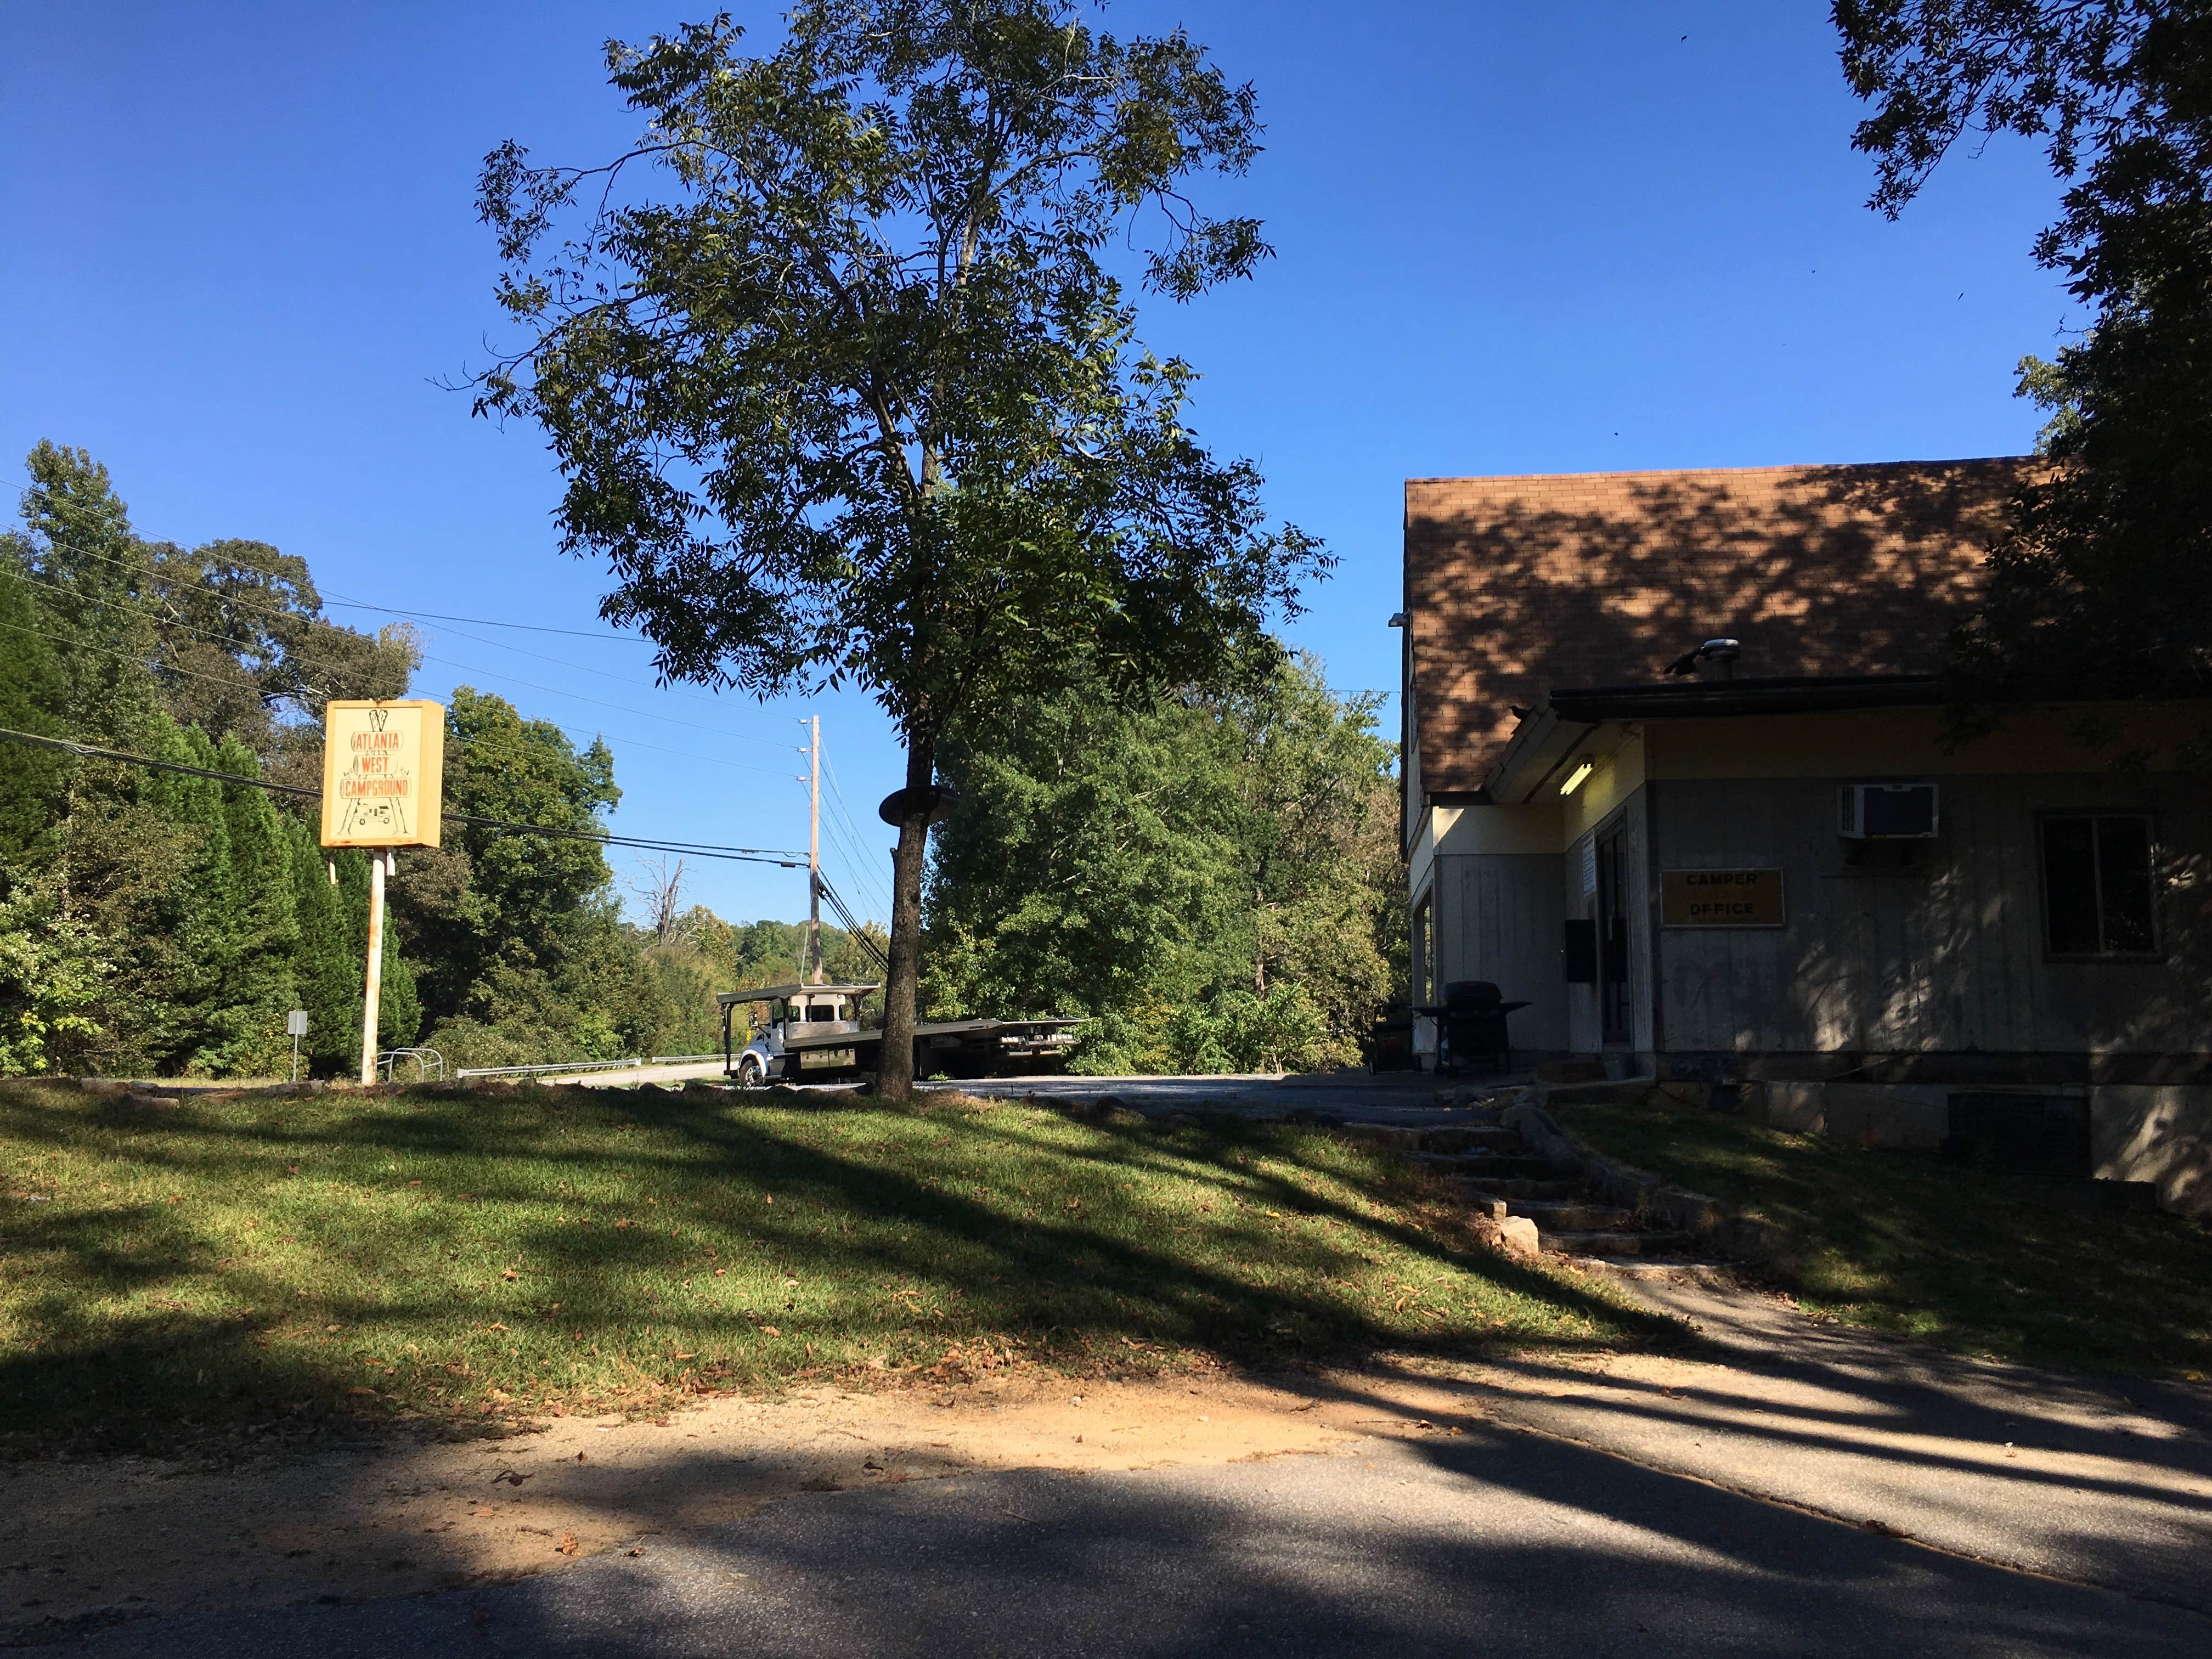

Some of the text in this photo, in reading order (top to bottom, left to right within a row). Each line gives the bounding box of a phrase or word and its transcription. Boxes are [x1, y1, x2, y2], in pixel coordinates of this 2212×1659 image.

[356, 733, 398, 749] ATLANTA
[362, 757, 388, 772] WEST
[345, 780, 408, 797] CAMPGROUND
[1686, 873, 1757, 885] CAMPER
[1690, 903, 1754, 915] OFFICE
